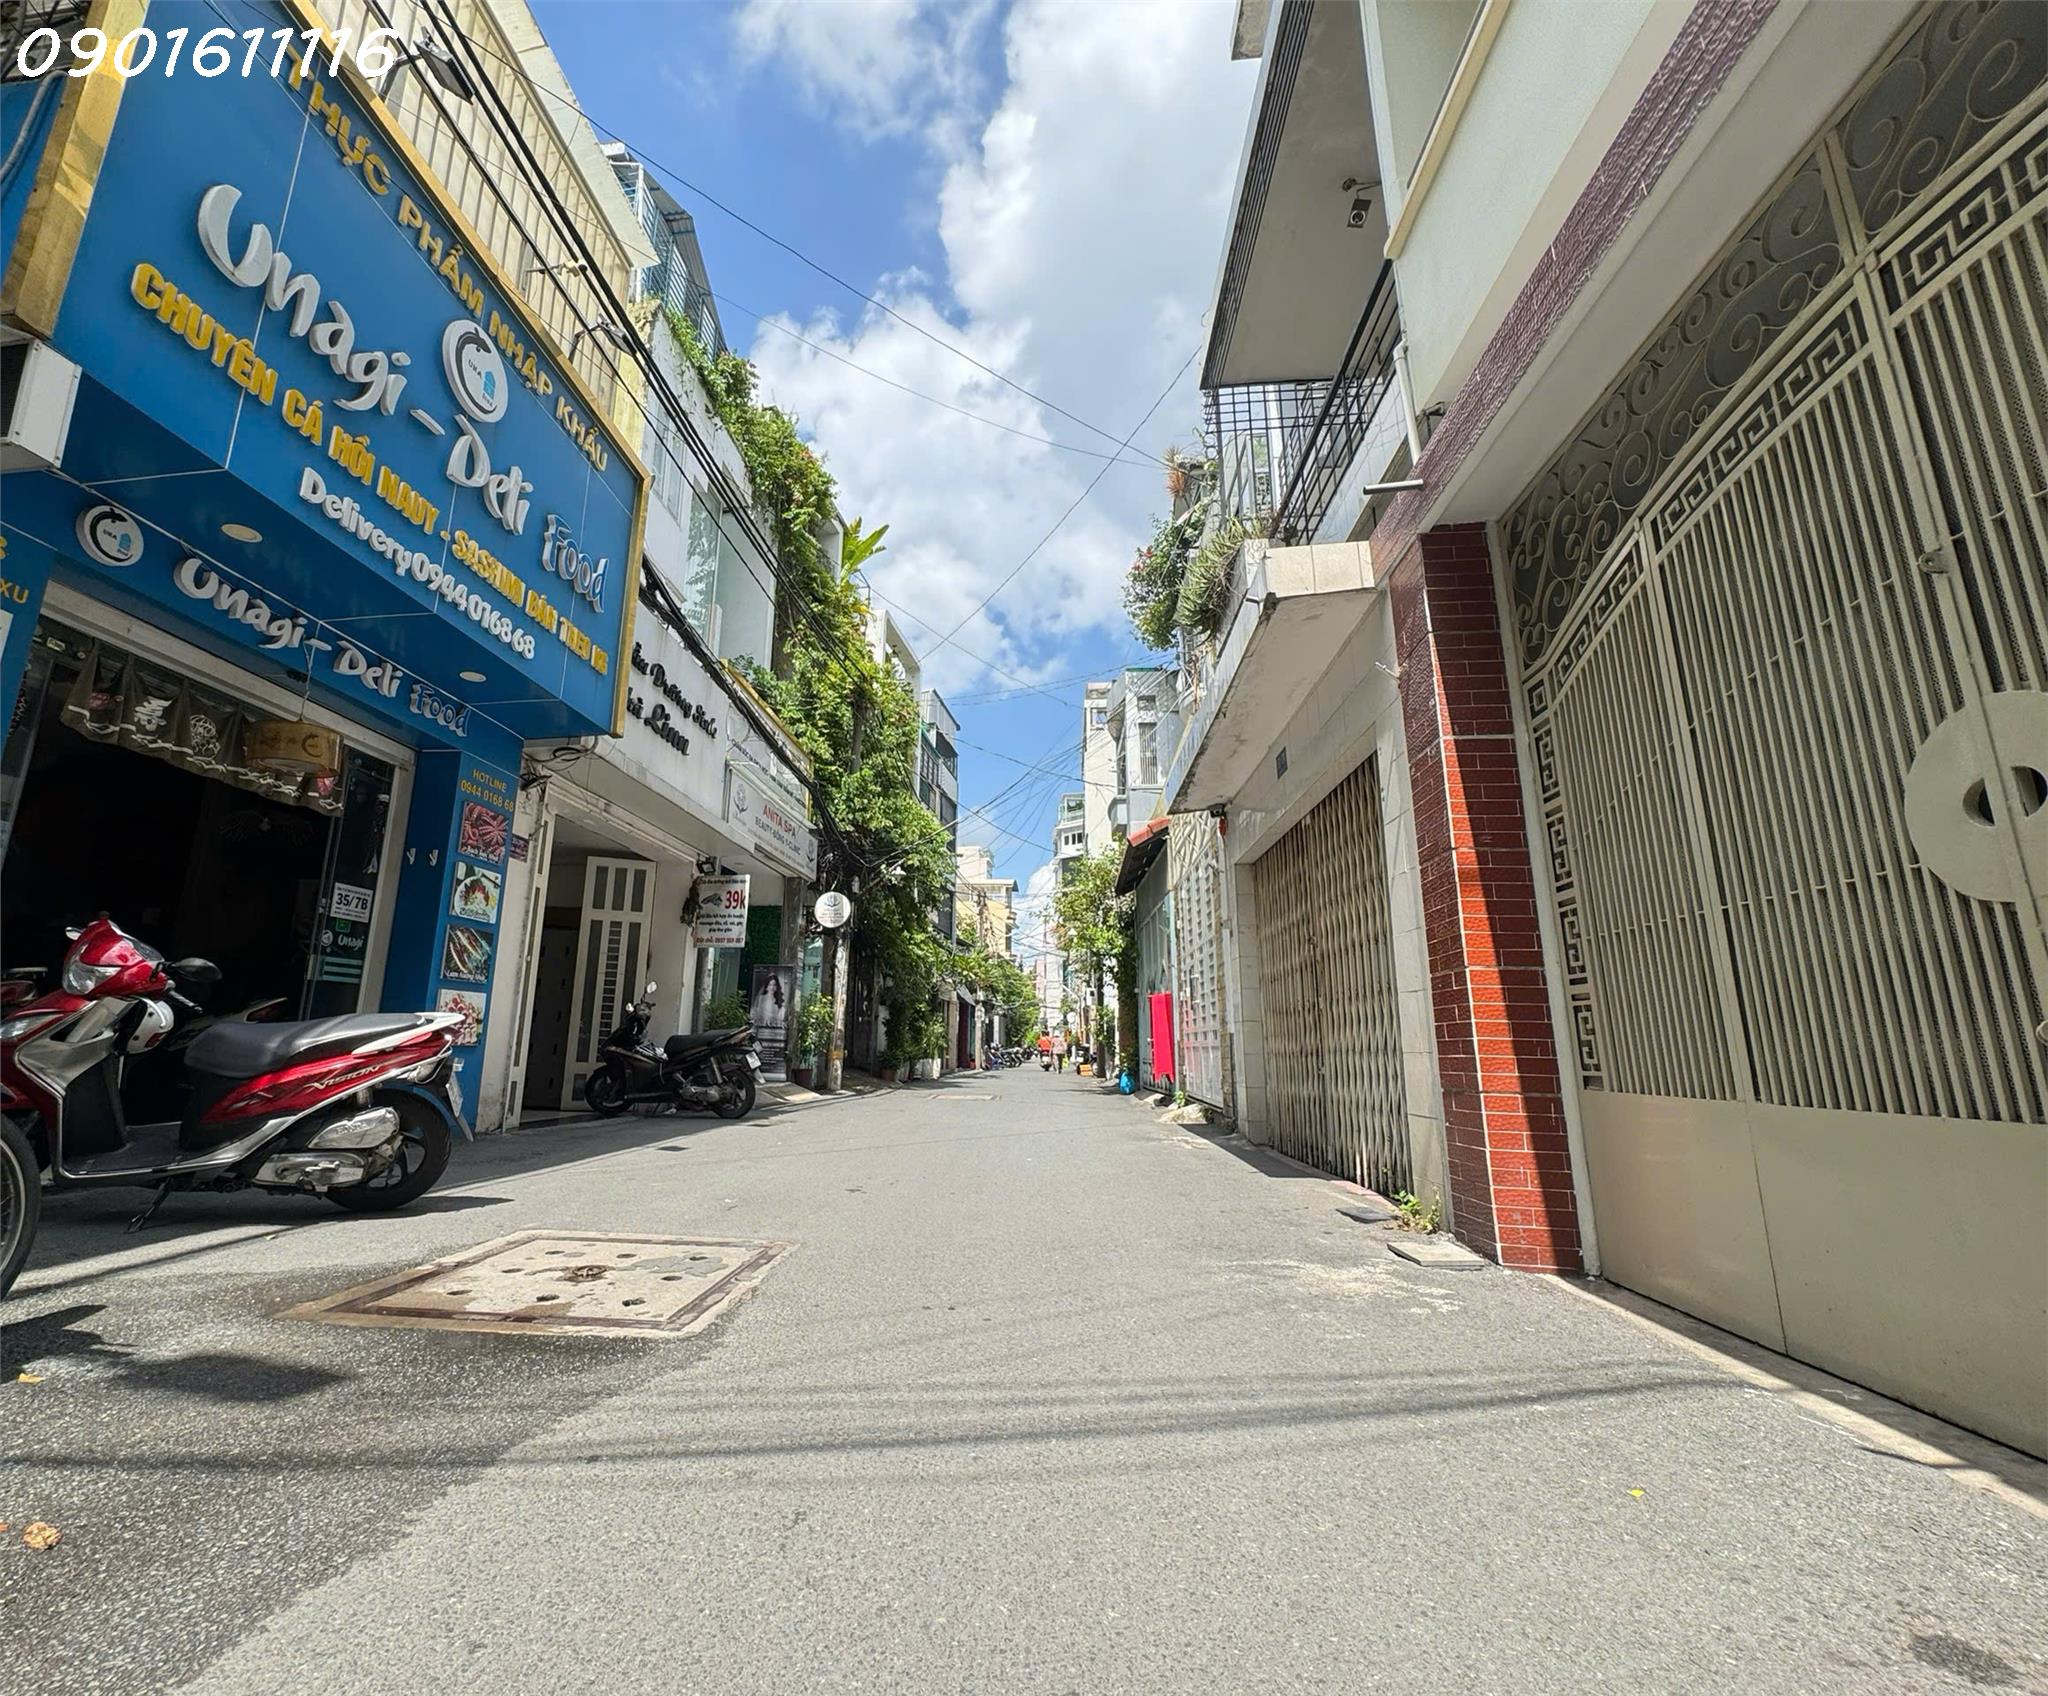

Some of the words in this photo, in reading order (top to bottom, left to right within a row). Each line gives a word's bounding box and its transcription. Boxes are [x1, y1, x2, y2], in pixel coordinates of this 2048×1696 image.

[286, 45, 391, 196] THỰC
[398, 193, 484, 318] PHẨM
[488, 310, 553, 396] NHẬP
[555, 396, 608, 472] KHẨU
[198, 184, 411, 416] Unagi
[446, 414, 534, 536] Deli
[131, 262, 278, 406] CHUYÊN
[282, 388, 323, 447] CÁ
[328, 425, 376, 485] HỒI
[377, 464, 440, 535] NAUY
[173, 557, 308, 650] Unagi
[333, 639, 404, 699] Deli
[461, 780, 481, 796] 0944
[472, 769, 507, 793] HOTLINE
[763, 804, 783, 828] ANITA
[724, 889, 746, 910] 39k
[338, 933, 365, 951] Unagi
[303, 1063, 381, 1090] VISION
